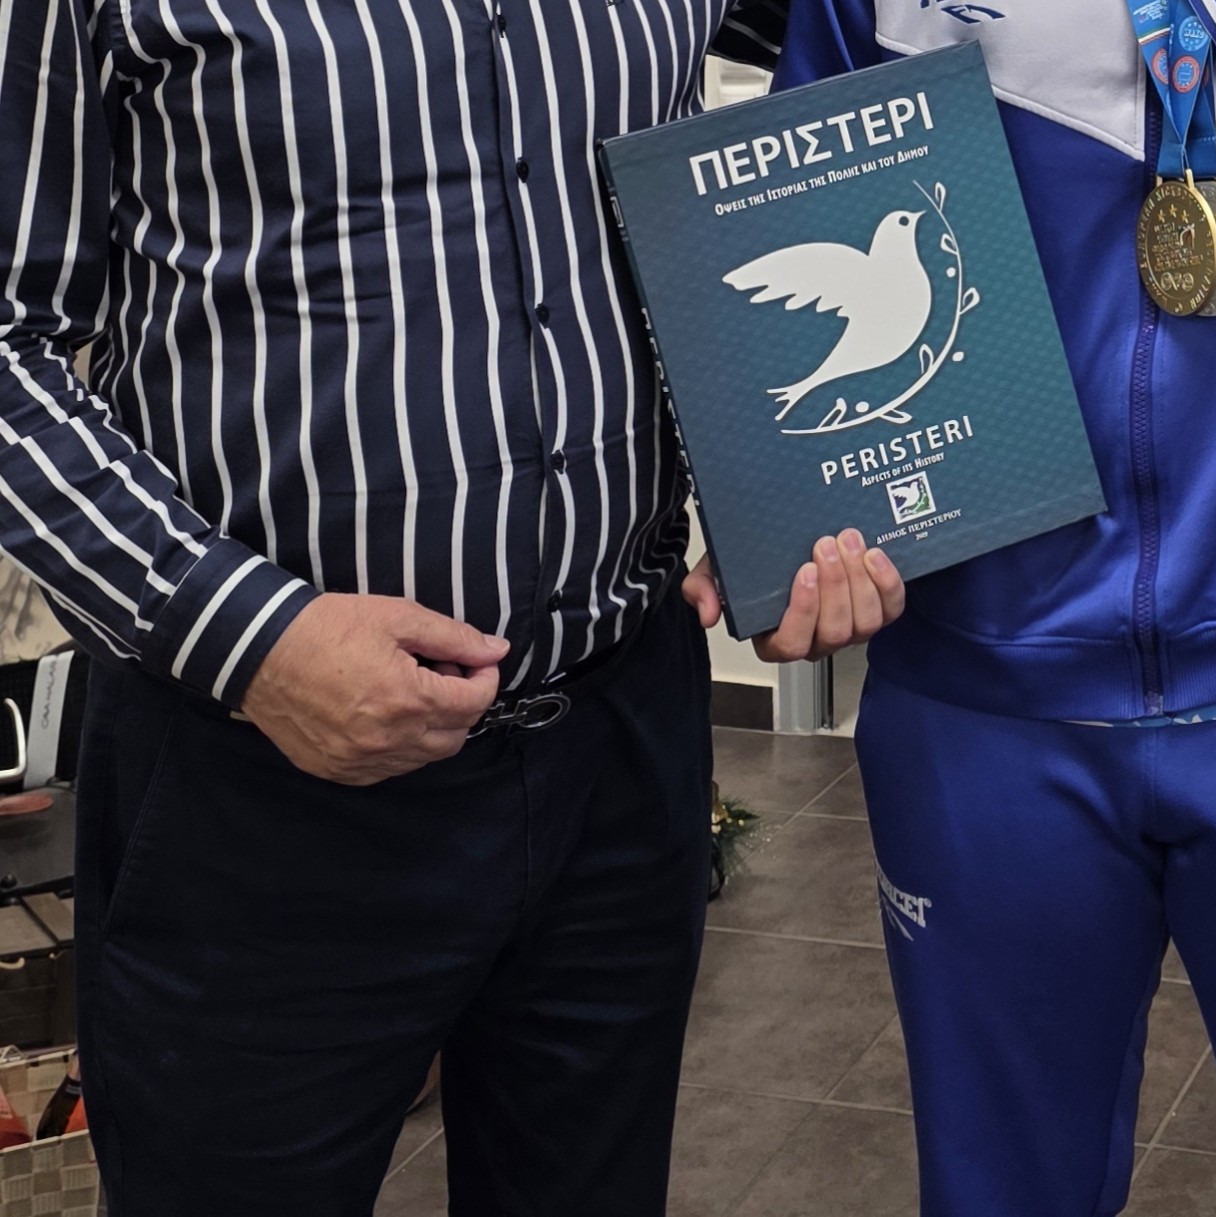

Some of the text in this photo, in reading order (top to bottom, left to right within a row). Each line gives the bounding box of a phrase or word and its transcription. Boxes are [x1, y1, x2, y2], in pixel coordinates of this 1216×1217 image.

[689, 91, 934, 196] ΠΕΡΙΣΤΕΡΙ
[821, 415, 974, 485] PERISTERI
[876, 509, 961, 544] ΔΗΜΟΣ ΠΕΡΙΣΤΕΡΙΟΥ
